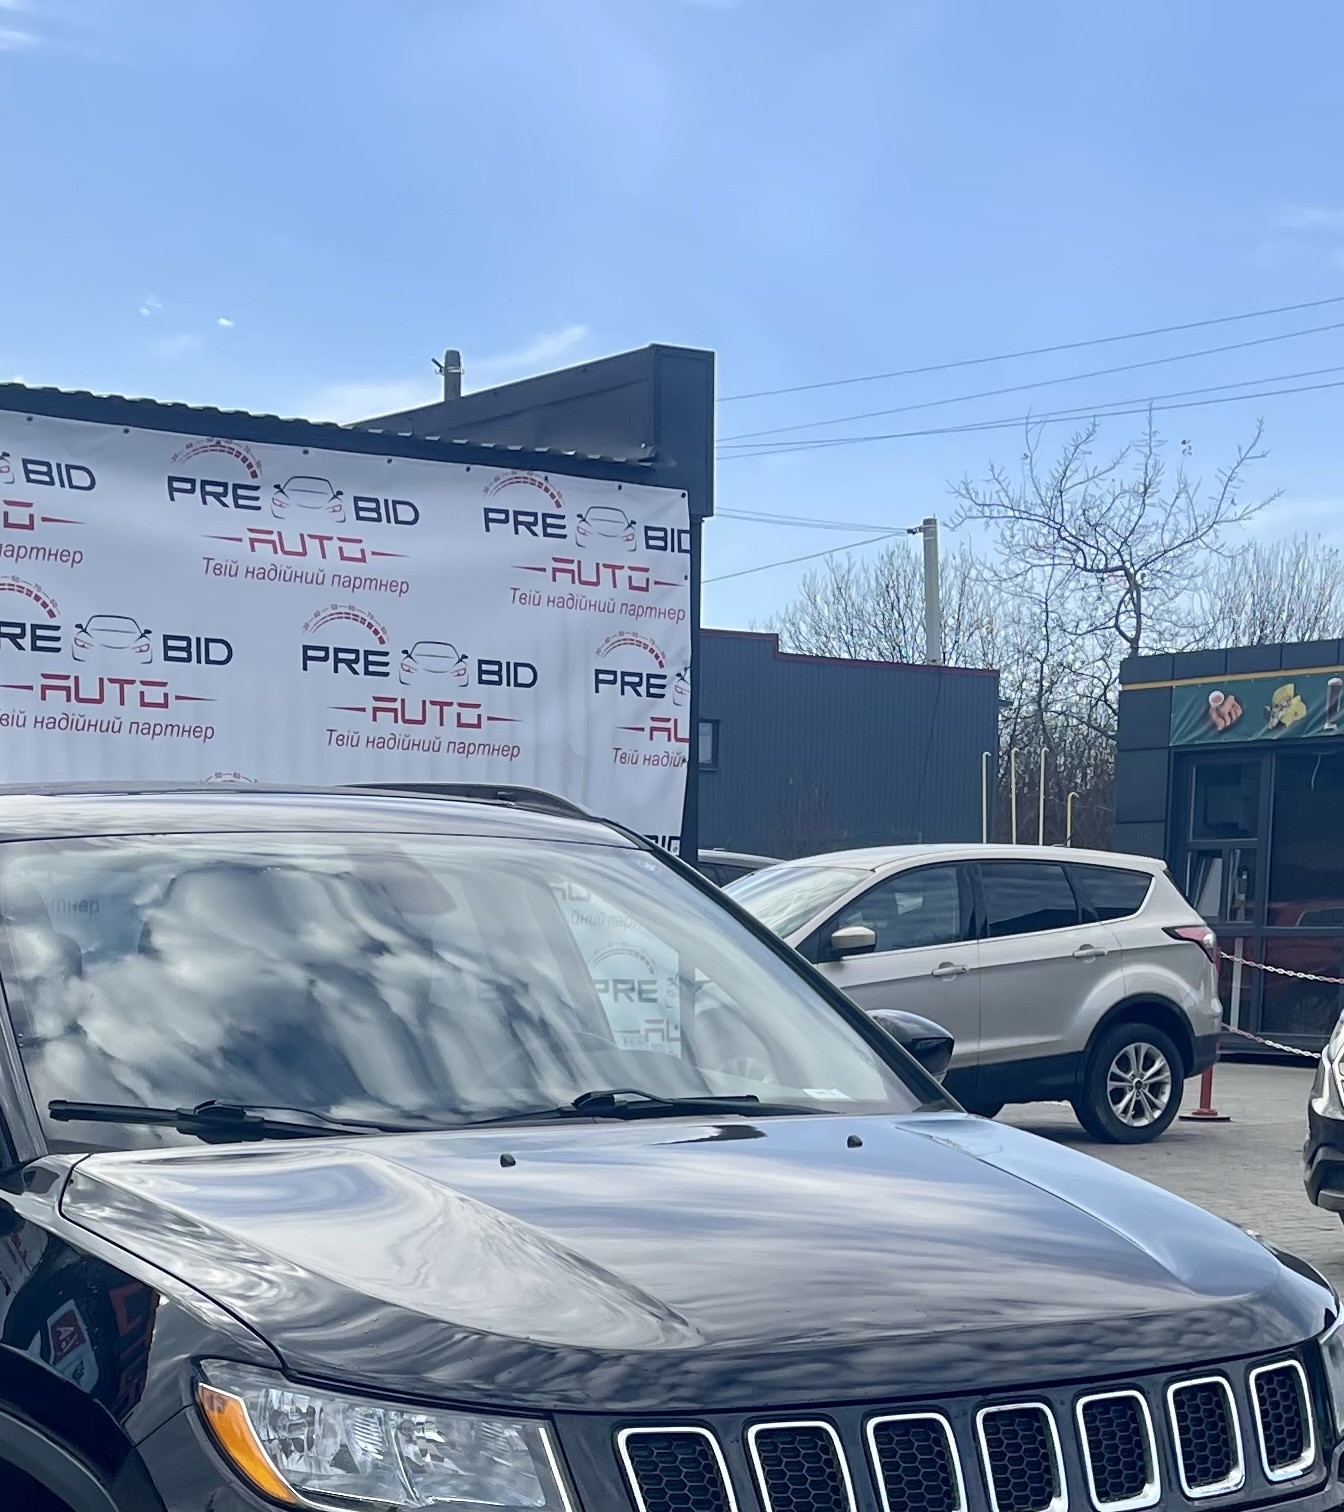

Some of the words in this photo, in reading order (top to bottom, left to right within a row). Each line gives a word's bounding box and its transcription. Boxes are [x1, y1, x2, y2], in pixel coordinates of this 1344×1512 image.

[22, 458, 96, 491] BID
[168, 475, 261, 511] PRE
[353, 496, 419, 525] BID
[483, 507, 567, 539] PRE
[247, 528, 367, 563] AUTO
[203, 557, 239, 577] Твій
[245, 564, 325, 585] надійний
[331, 574, 409, 598] партнер
[552, 557, 650, 592] AUTO
[510, 587, 541, 606] Твій
[547, 593, 615, 613] надійний
[620, 603, 685, 624] партнер
[163, 634, 233, 665] BID
[302, 645, 390, 677] PRE
[478, 659, 538, 688] BID
[41, 673, 169, 709] AUTO
[595, 669, 667, 699] PRE
[34, 712, 122, 734] надійний
[129, 722, 214, 743] партнер
[372, 696, 481, 729] AUTO
[649, 715, 689, 743] AU
[326, 729, 360, 747] Твій
[366, 733, 441, 752] надійний
[447, 741, 520, 761] партнер
[613, 747, 639, 765] Твій
[642, 752, 685, 769] надій
